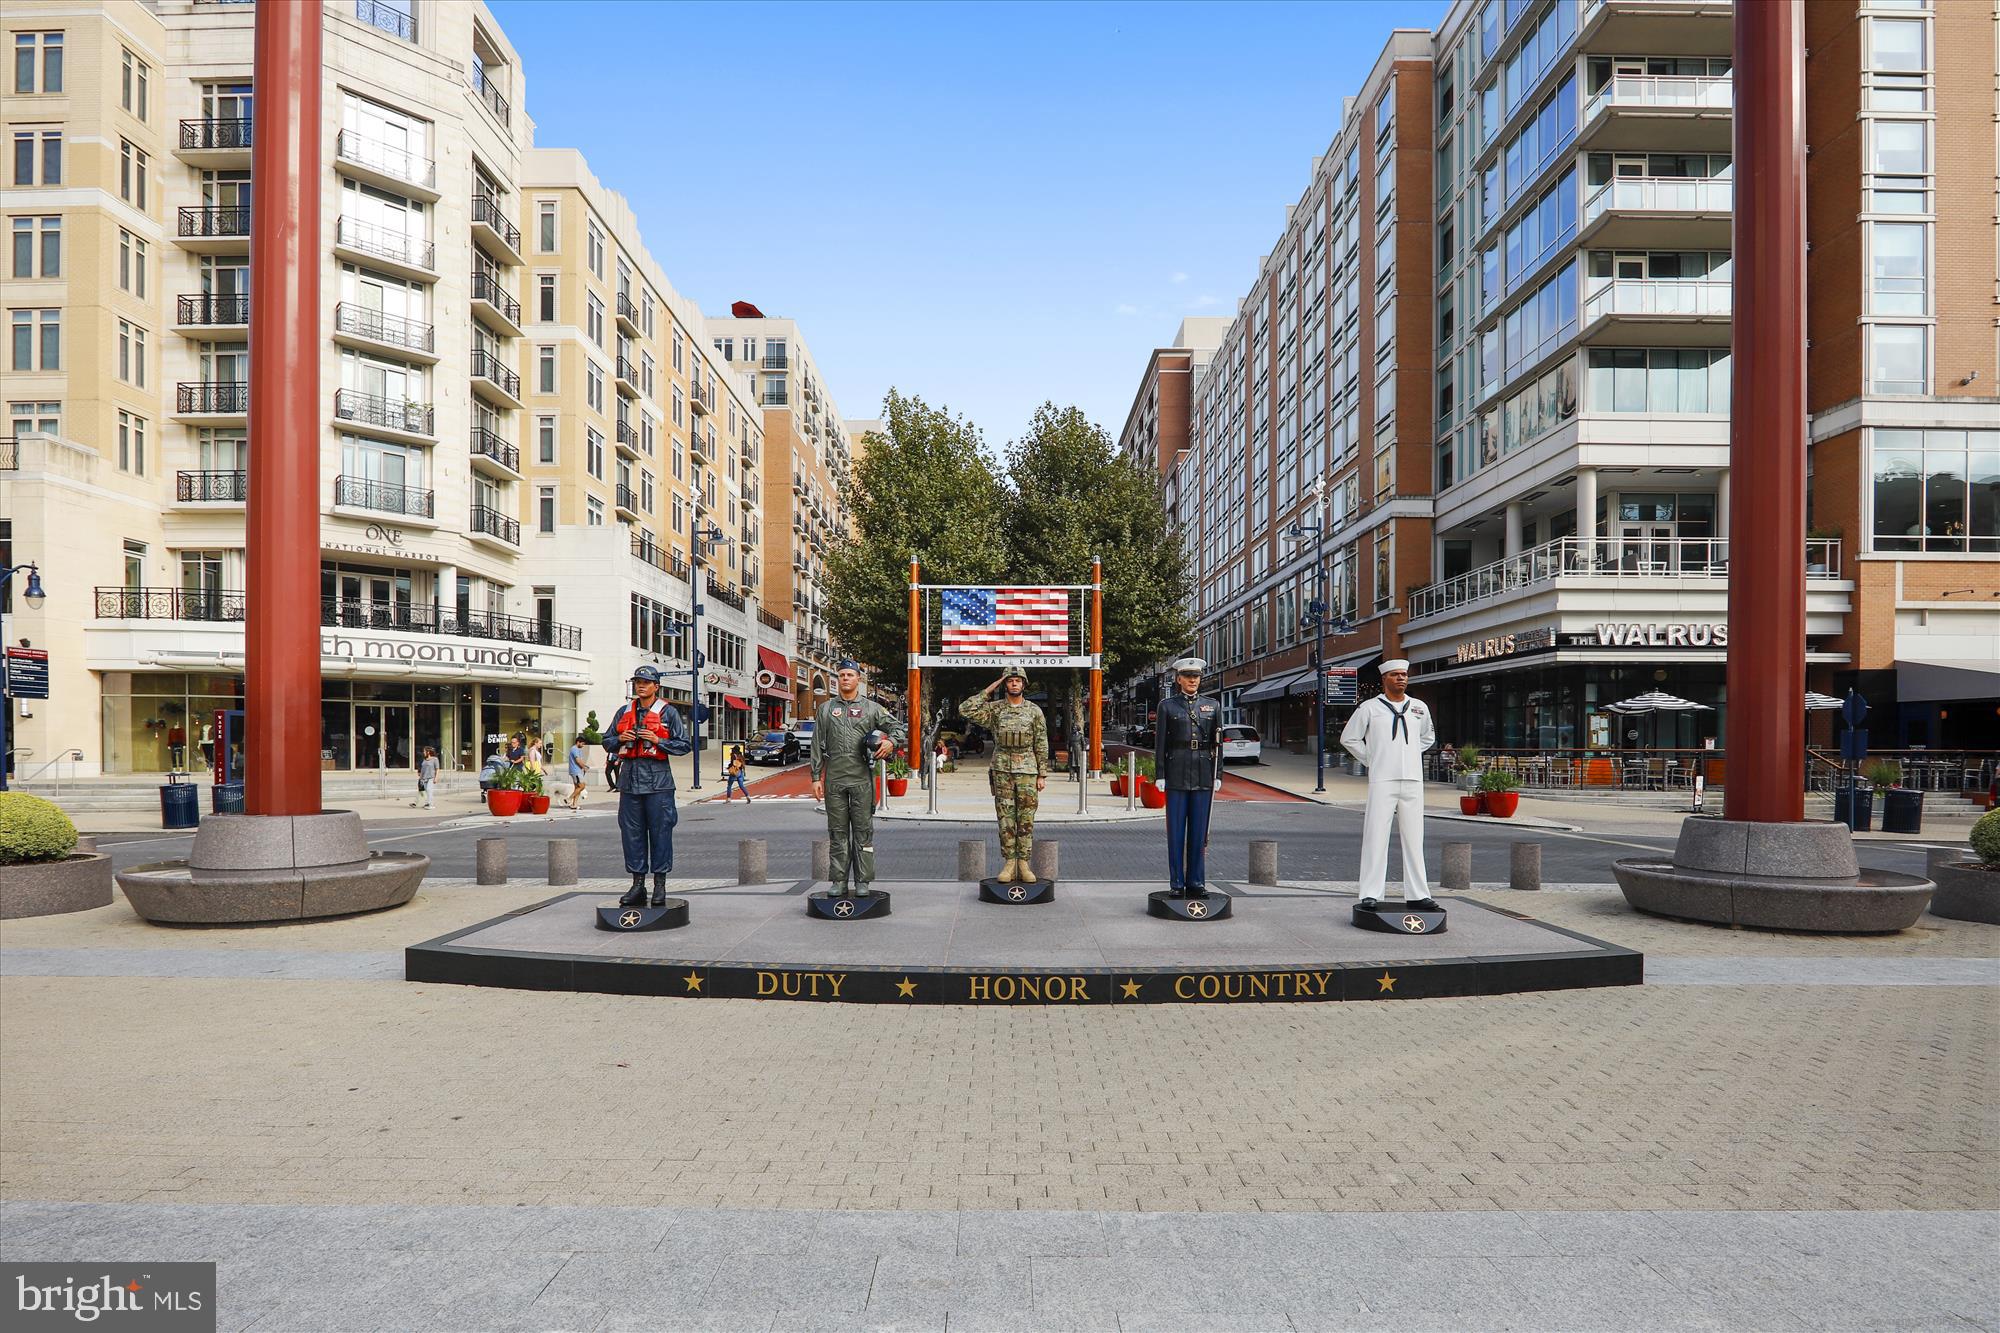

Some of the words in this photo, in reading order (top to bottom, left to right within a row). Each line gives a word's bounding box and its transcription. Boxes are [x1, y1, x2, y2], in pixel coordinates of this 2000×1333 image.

[366, 523, 404, 546] ONE
[325, 542, 387, 555] NATIONAL
[395, 550, 439, 561] HARBOR
[1569, 636, 1596, 646] THE
[1596, 624, 1728, 646] WALRUS
[364, 641, 455, 662] moon
[463, 648, 539, 667] under
[1457, 634, 1515, 663] WALRUS
[756, 972, 848, 997] DUTY
[968, 976, 1091, 1001] HONOR
[1174, 972, 1335, 999] COUNTRY
